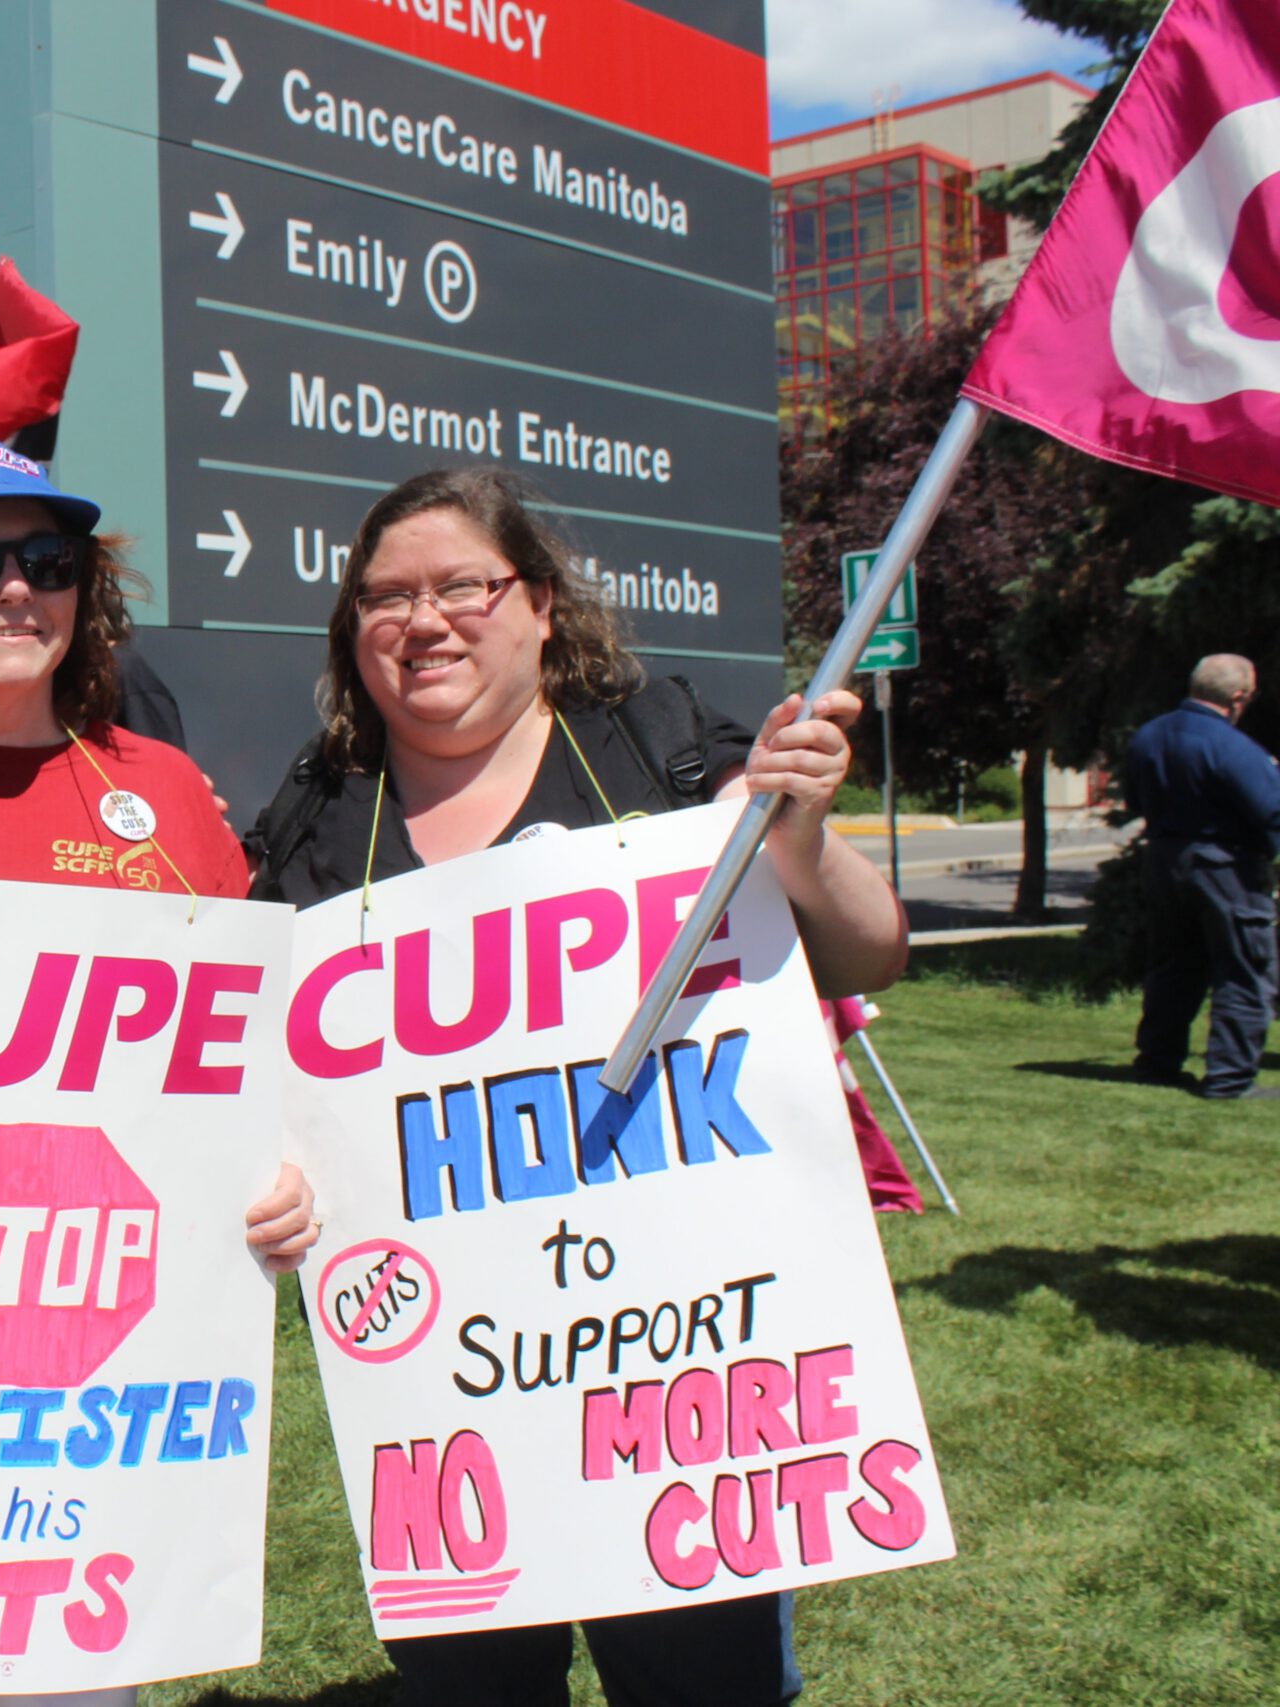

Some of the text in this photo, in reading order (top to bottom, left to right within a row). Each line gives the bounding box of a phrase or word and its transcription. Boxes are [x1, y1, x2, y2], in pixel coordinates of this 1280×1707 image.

[282, 69, 690, 236] CancerCare Manitoba
[286, 218, 407, 306] Emily
[289, 371, 672, 482] McDermot Entrance
[52, 839, 115, 860] CUPE
[52, 855, 114, 875] SCFP
[395, 1027, 773, 1222] HONK
[335, 1250, 420, 1344] CUTS
[542, 1219, 615, 1290] to
[582, 1344, 860, 1482] MORE
[1, 1486, 86, 1542] his
[370, 1428, 508, 1574] NO
[644, 1438, 927, 1591] CUTS
